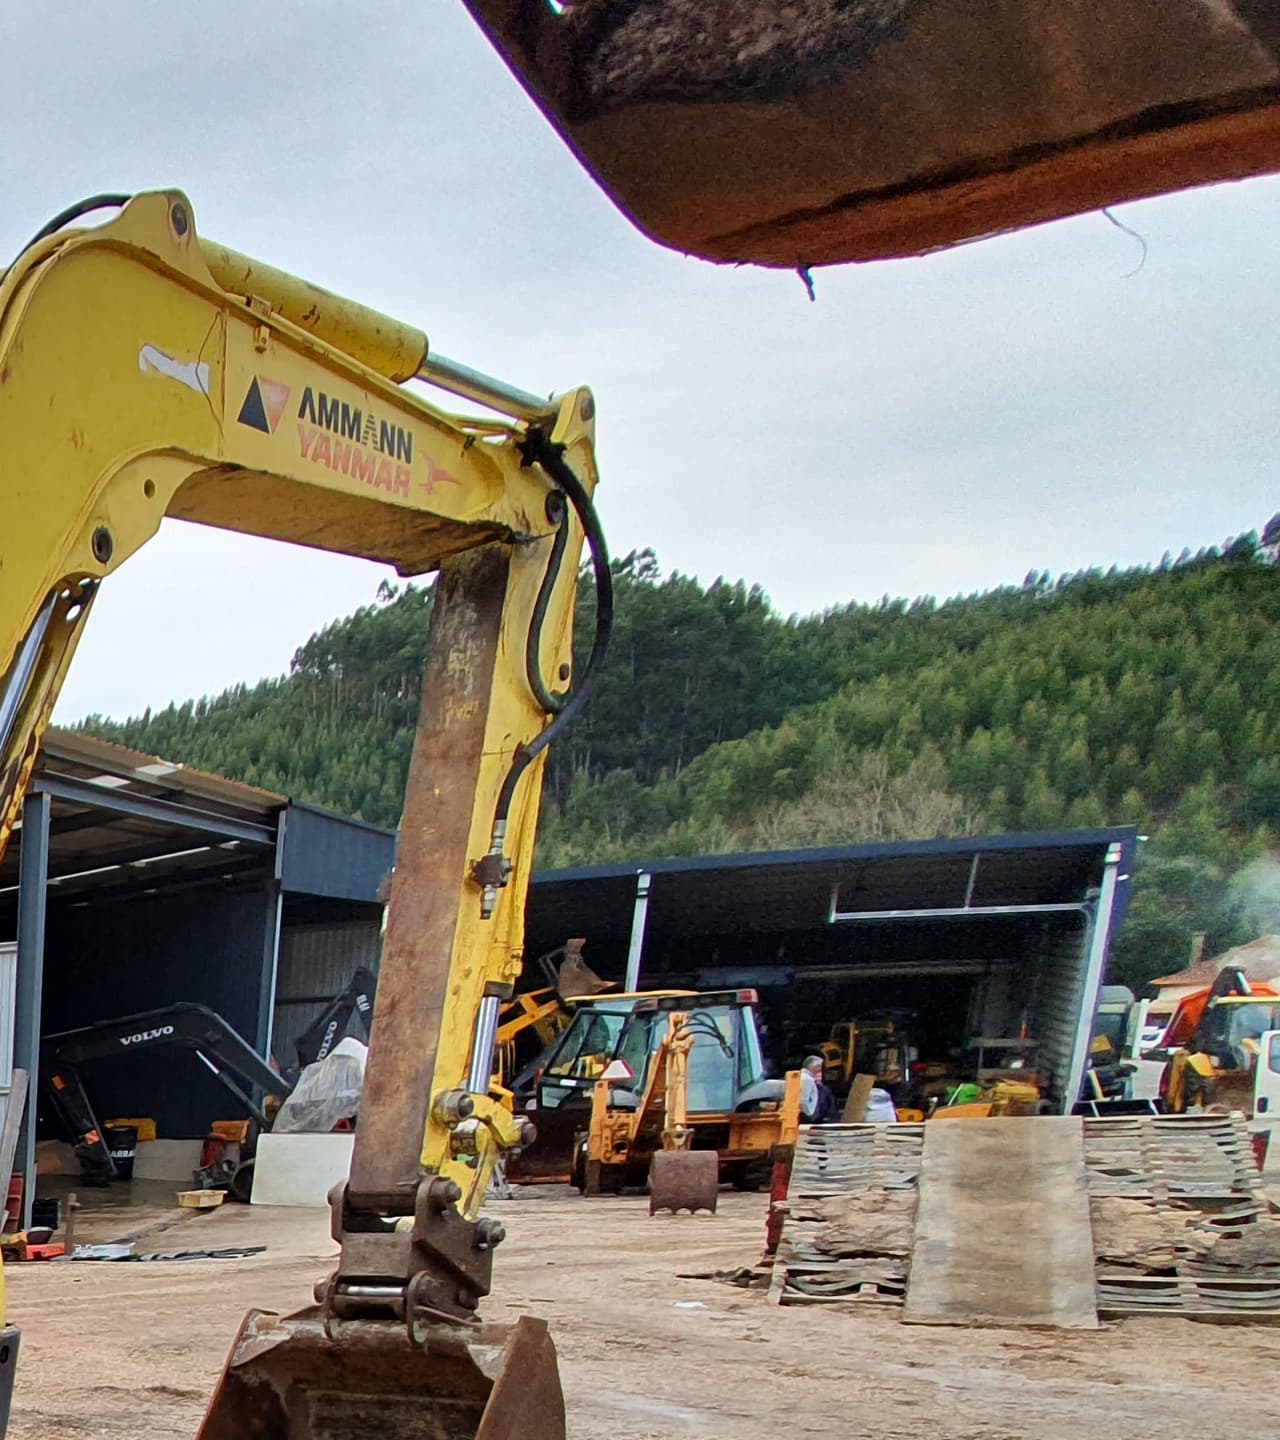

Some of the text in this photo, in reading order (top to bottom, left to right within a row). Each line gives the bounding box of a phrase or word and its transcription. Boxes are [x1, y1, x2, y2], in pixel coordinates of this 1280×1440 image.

[297, 423, 412, 498] YANMAR
[298, 385, 413, 465] AMMANN
[120, 1025, 174, 1046] VOLVO
